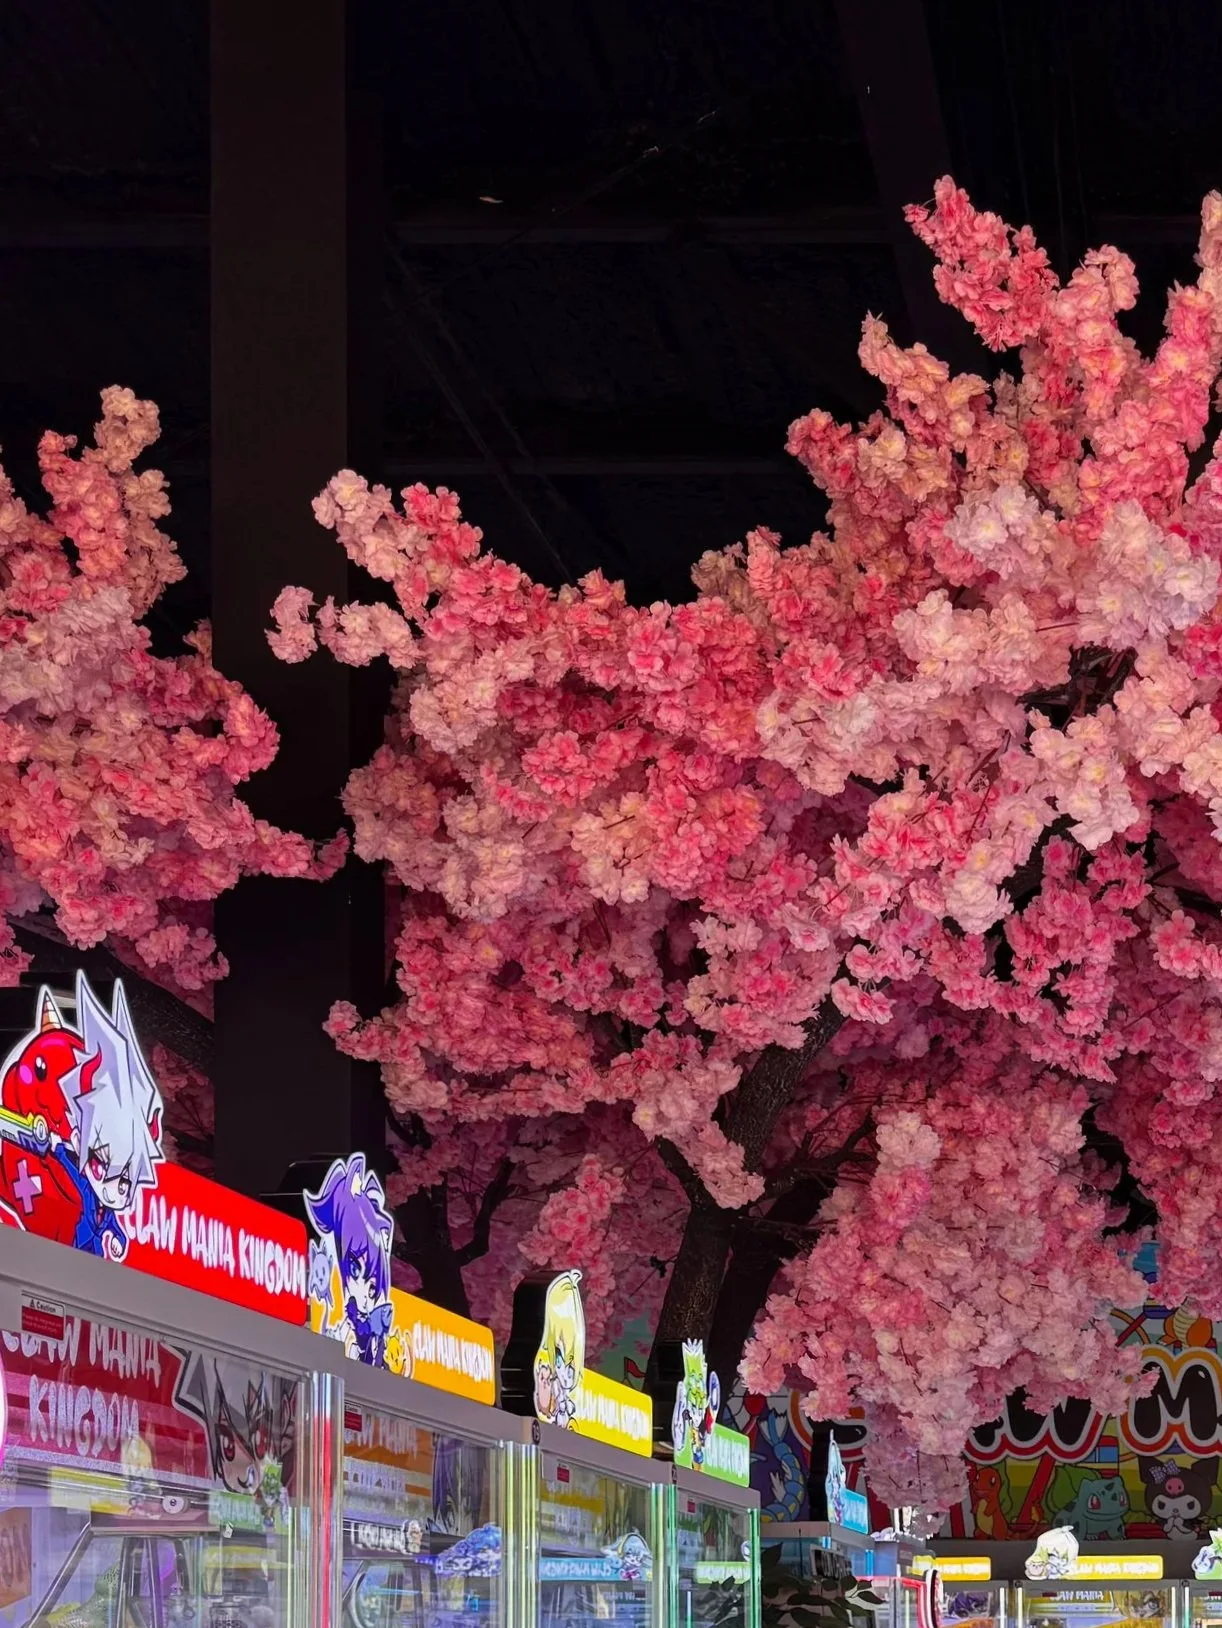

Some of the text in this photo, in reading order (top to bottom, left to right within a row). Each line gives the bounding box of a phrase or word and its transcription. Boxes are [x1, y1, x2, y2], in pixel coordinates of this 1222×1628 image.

[125, 1190, 307, 1300] CLAW MANIA KINGDOM
[28, 1374, 141, 1458] KINGDOM
